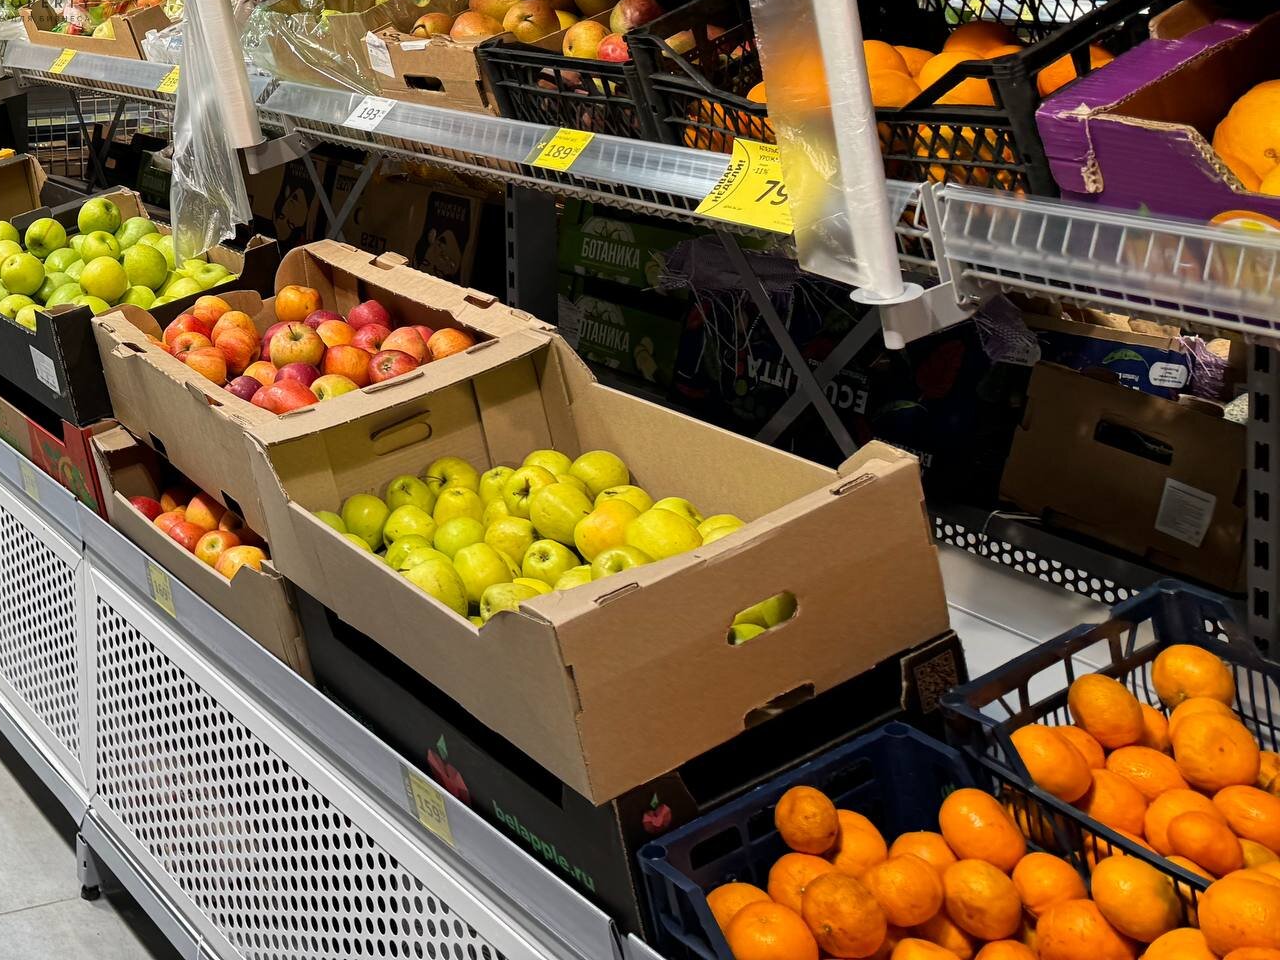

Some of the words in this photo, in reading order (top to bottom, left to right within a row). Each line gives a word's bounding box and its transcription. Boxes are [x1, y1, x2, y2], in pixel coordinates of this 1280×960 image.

[357, 106, 381, 121] 193
[544, 144, 573, 160] 189
[709, 163, 734, 196] ТОВАР
[711, 159, 747, 203] НЕДЕЛИ!
[581, 237, 641, 270] БОТАНИКА
[577, 318, 631, 353] ОТАНИКА
[491, 799, 597, 893] belapple.ru
